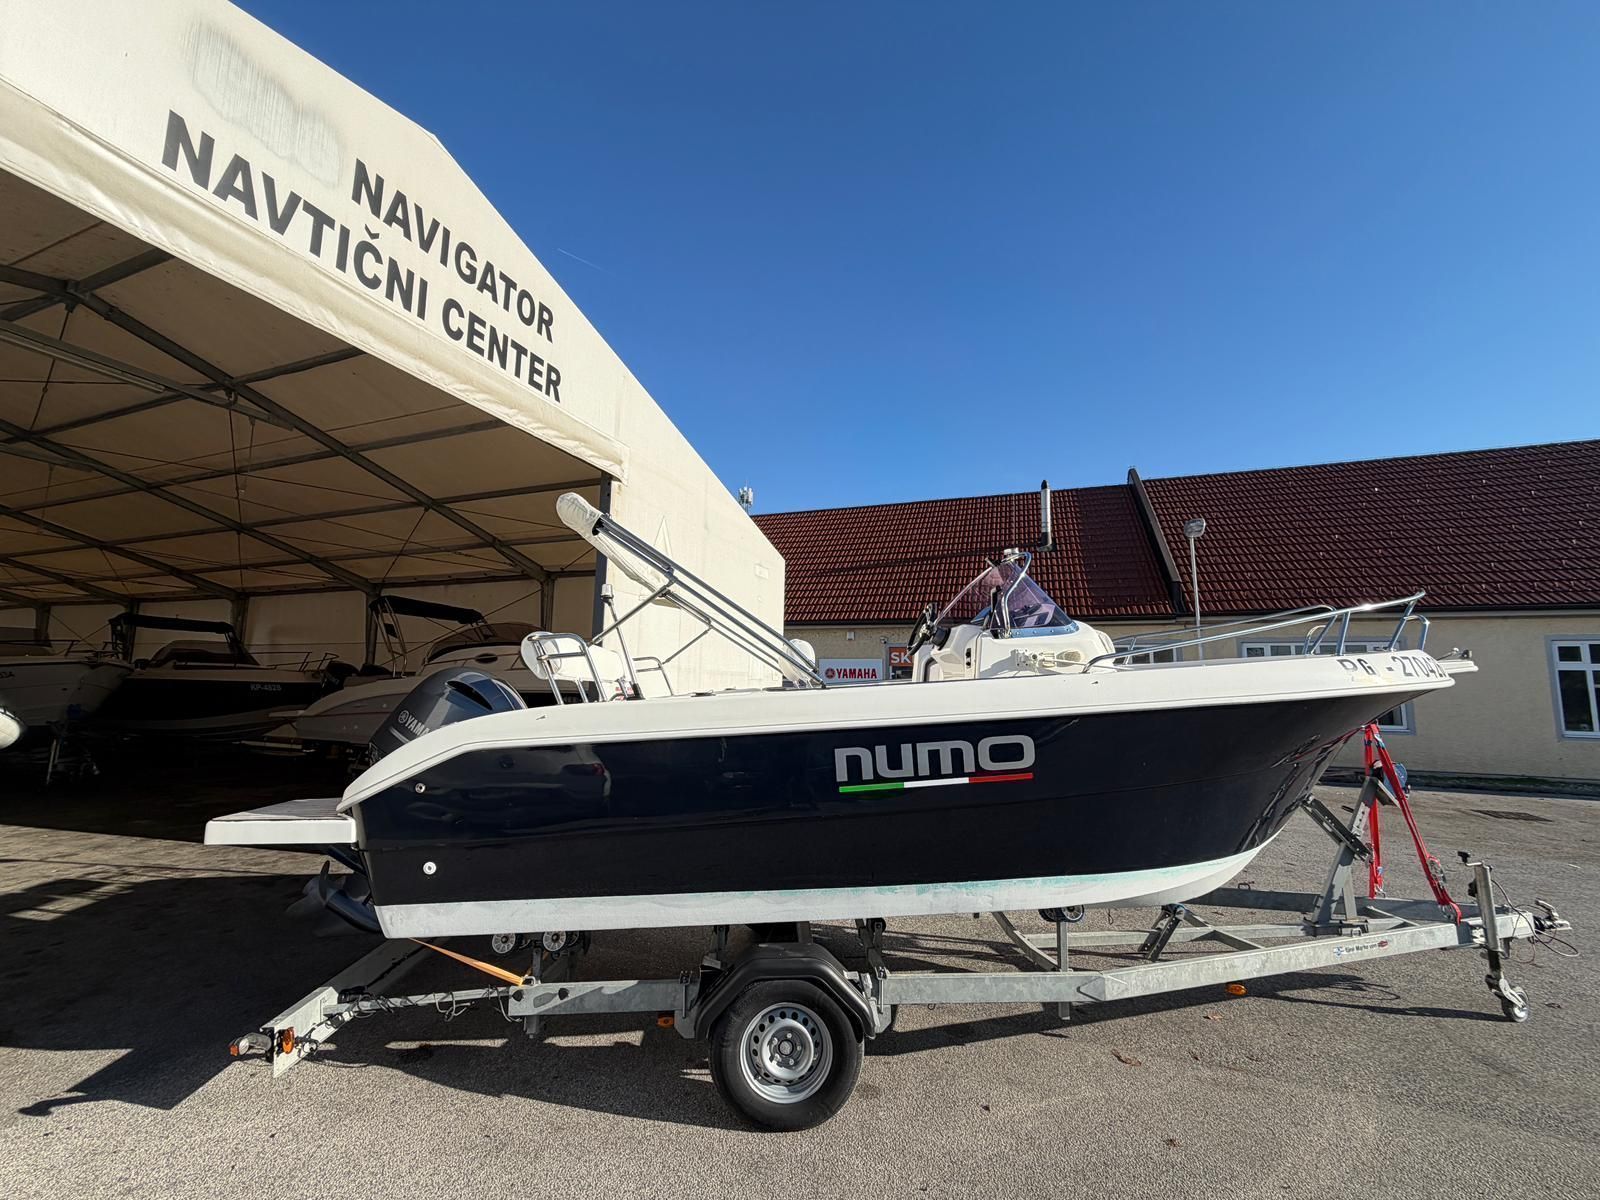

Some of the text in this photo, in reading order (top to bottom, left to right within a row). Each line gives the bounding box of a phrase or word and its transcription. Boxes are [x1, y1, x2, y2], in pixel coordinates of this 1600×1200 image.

[161, 109, 562, 403] NAVTIČNI CENTER
[351, 158, 555, 342] NAVIGATOR
[836, 668, 877, 679] YAMAHA
[404, 714, 431, 736] YAMA
[834, 734, 1036, 782] numo
